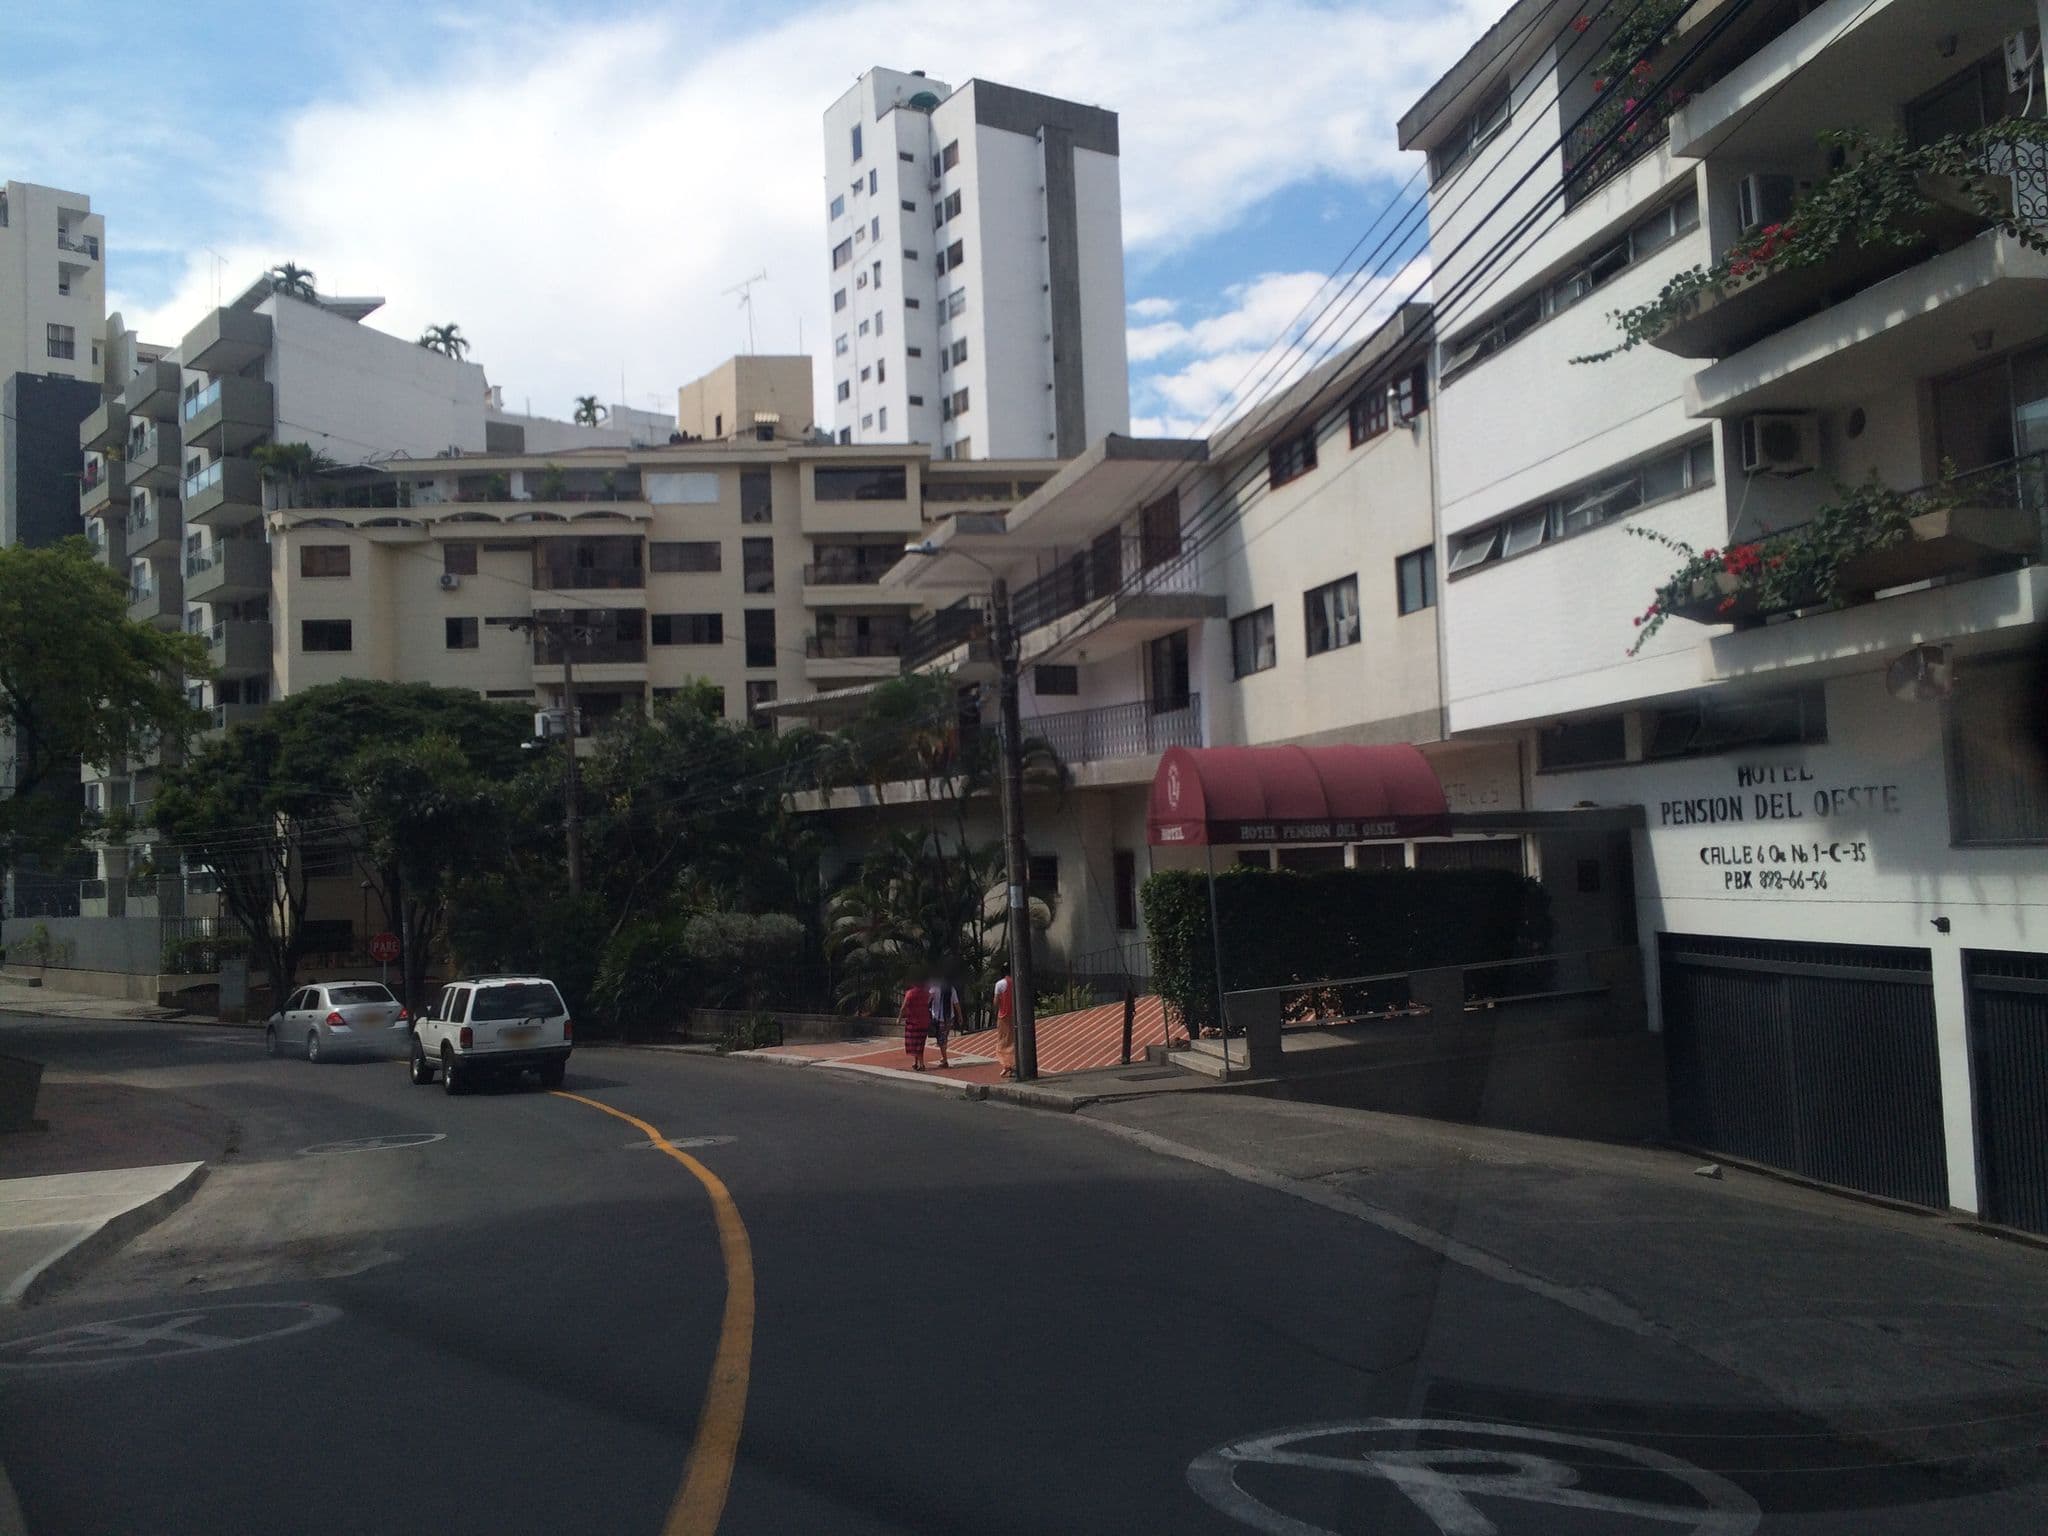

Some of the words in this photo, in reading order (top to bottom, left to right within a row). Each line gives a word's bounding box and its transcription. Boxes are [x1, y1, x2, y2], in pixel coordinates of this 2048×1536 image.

[1738, 767, 1813, 788] HOTEL
[1661, 795, 1743, 825] PENSION
[1755, 792, 1802, 820] DEL
[1814, 785, 1901, 818] OESTE
[1161, 827, 1185, 841] HOTEL
[1240, 824, 1277, 840] HOTEL
[1283, 823, 1331, 839] PENSION
[1336, 822, 1358, 837] DEL
[1363, 822, 1398, 836] OESTE
[1700, 845, 1753, 866] CALLE
[1757, 845, 1765, 865] 6
[1813, 842, 1866, 863] 1-C-35
[1725, 870, 1753, 890] PBX
[1760, 870, 1828, 890] 892-66-56
[373, 941, 400, 953] PARE
